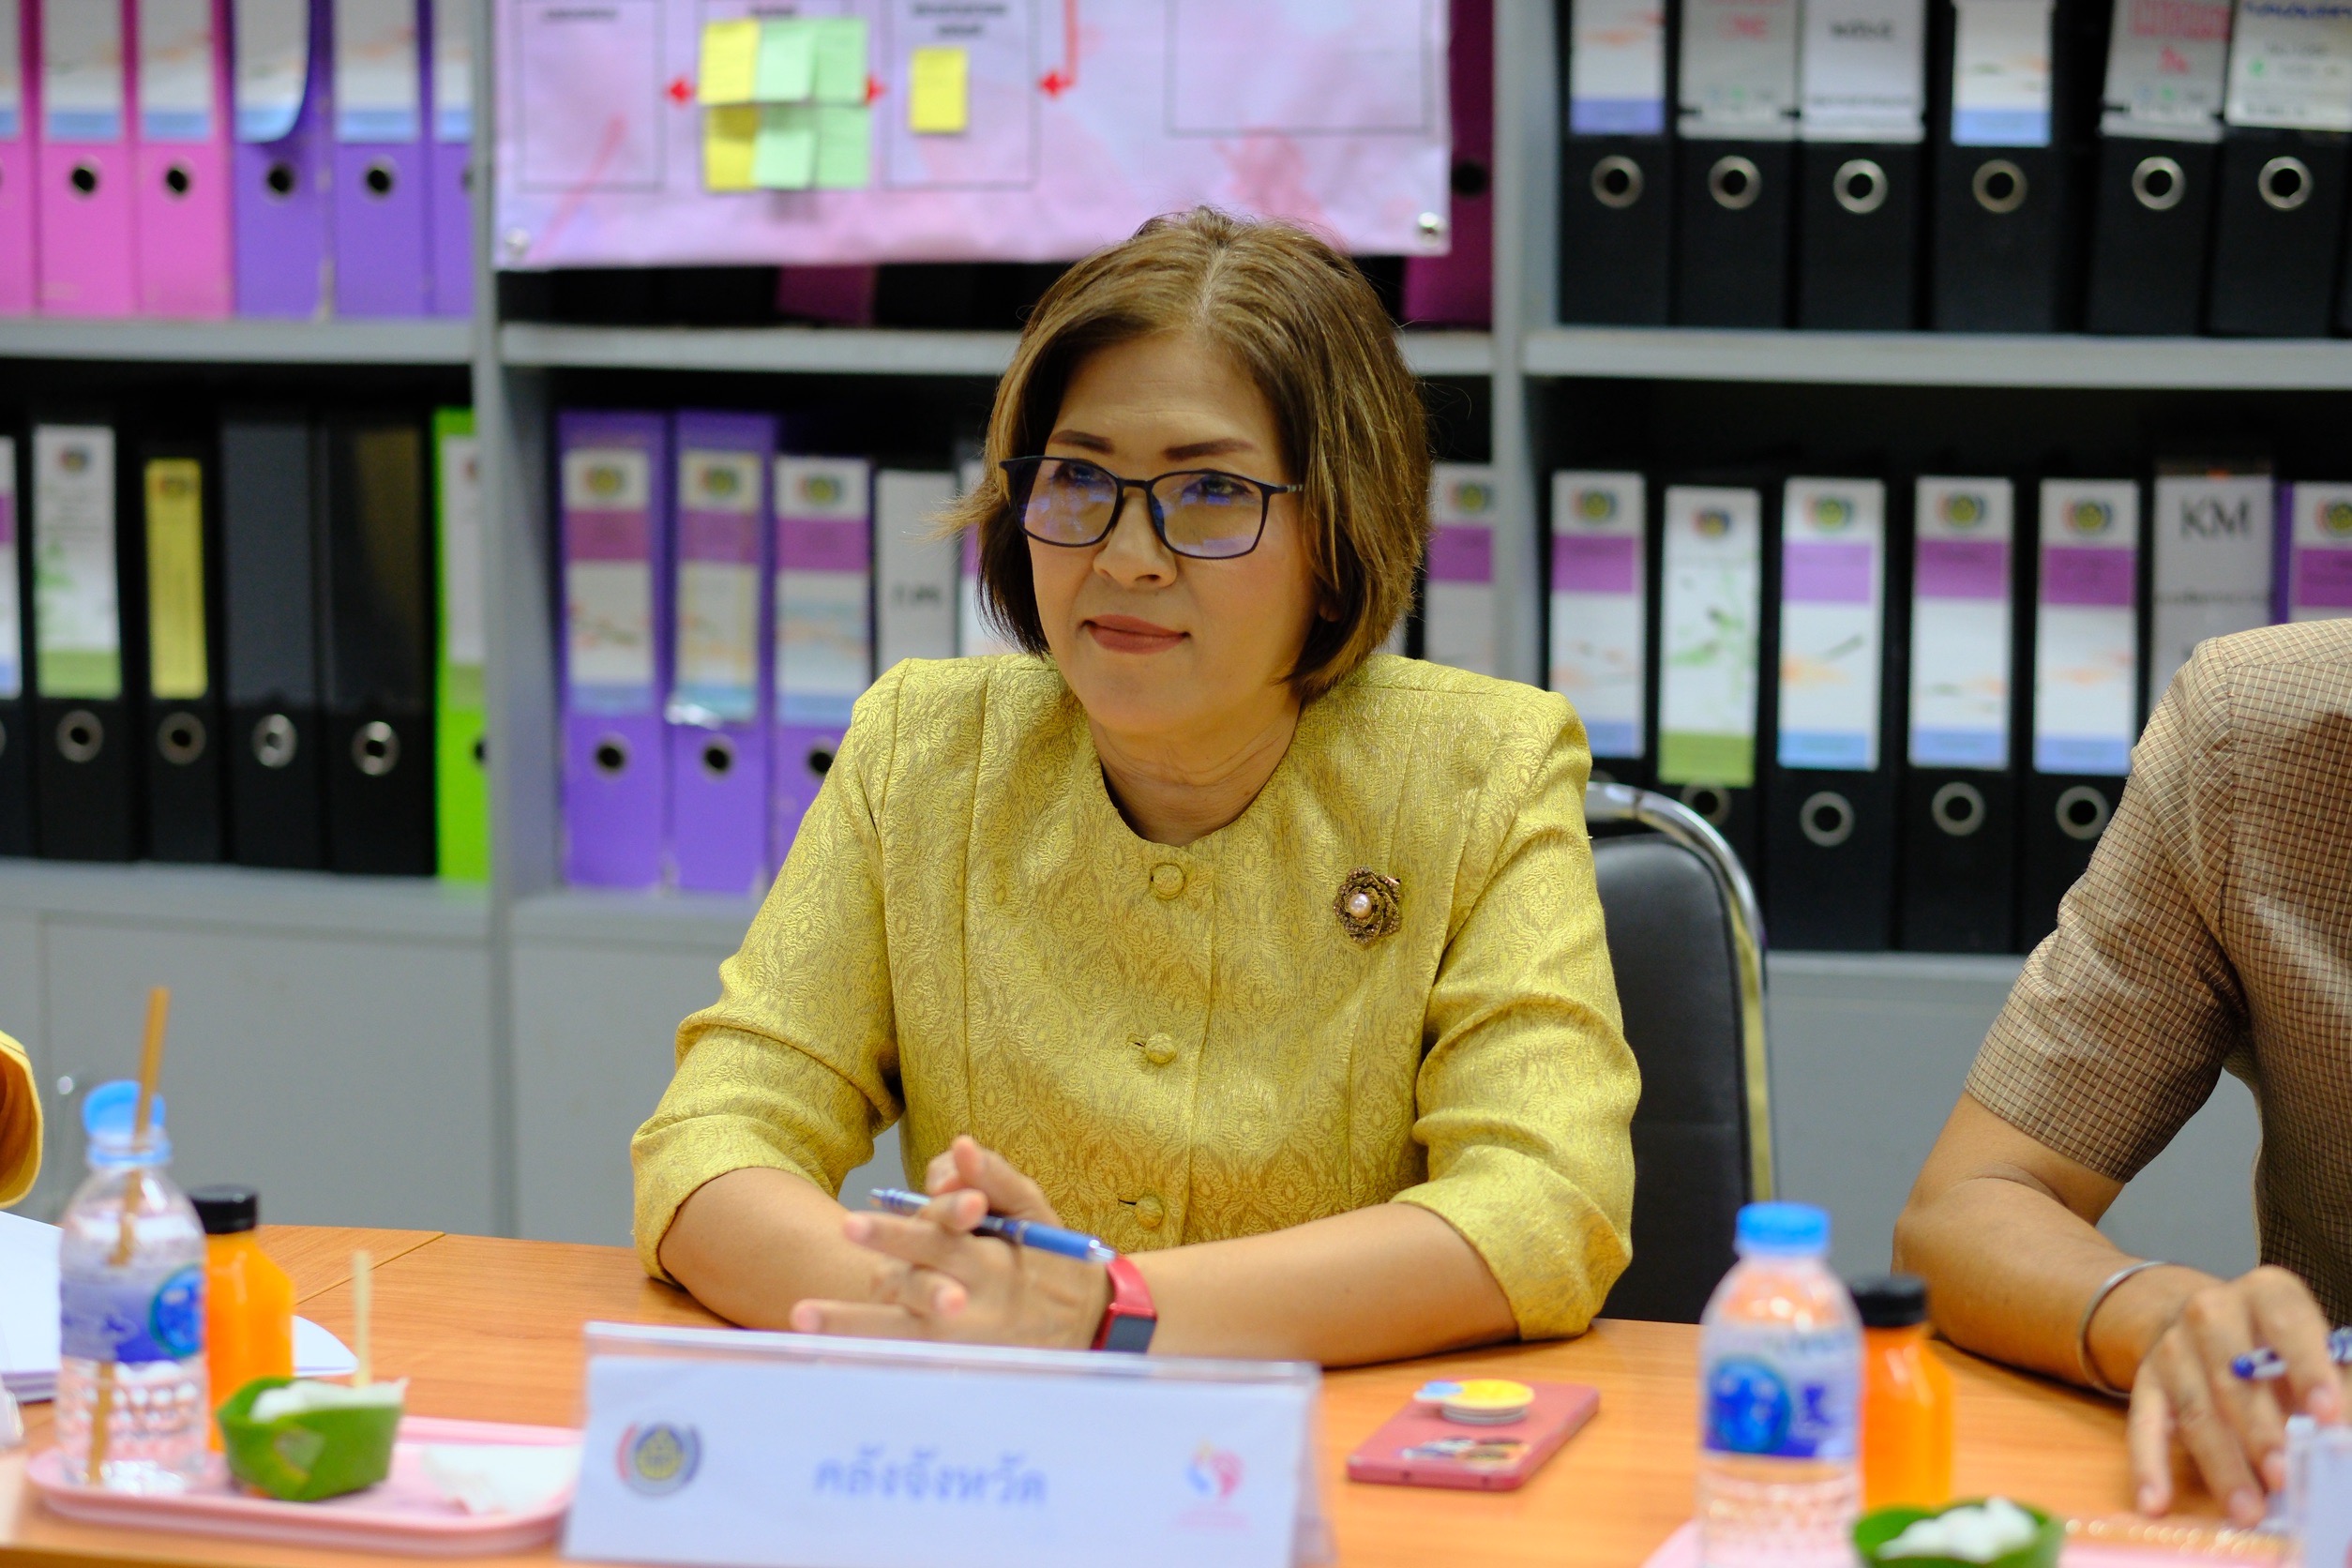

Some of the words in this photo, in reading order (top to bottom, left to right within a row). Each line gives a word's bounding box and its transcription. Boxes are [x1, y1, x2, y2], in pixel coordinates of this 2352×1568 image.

[2180, 495, 2250, 538] KM
[814, 1445, 1048, 1503] คลังจังหวัด
